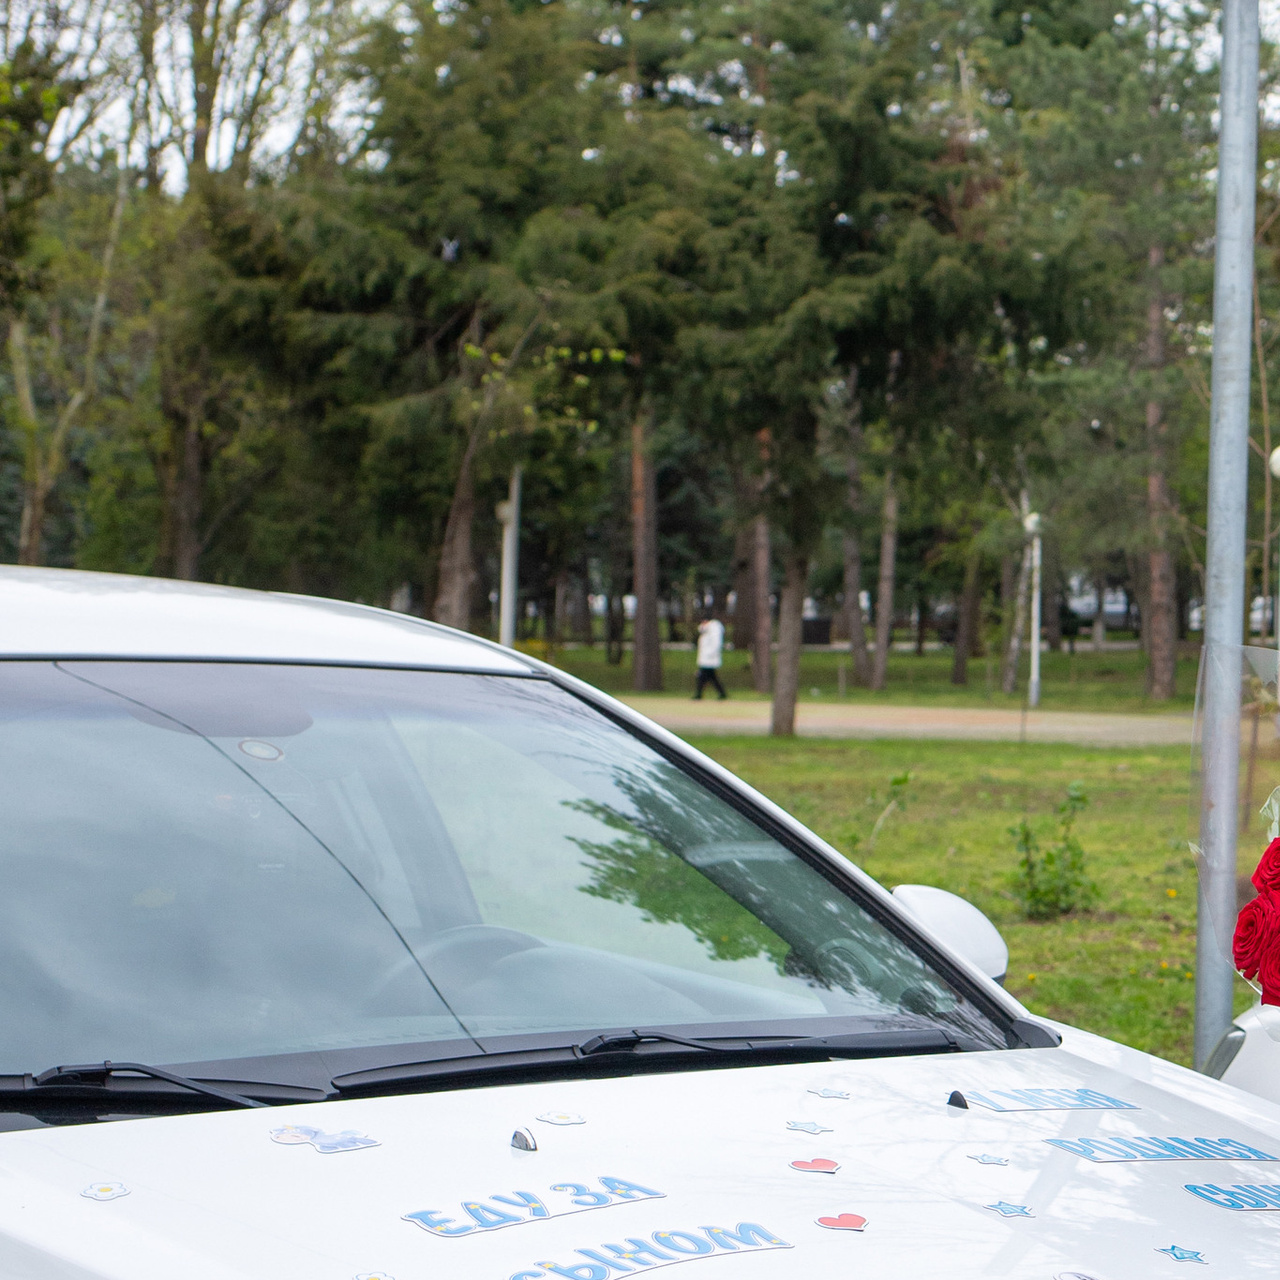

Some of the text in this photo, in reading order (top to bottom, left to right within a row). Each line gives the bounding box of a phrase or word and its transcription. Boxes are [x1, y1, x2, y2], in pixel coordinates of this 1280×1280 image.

[989, 1088, 1137, 1109] МЕНЯ
[1045, 1136, 1279, 1160] РОДИЛСЯ
[404, 1176, 664, 1235] ЕДУ ЗА
